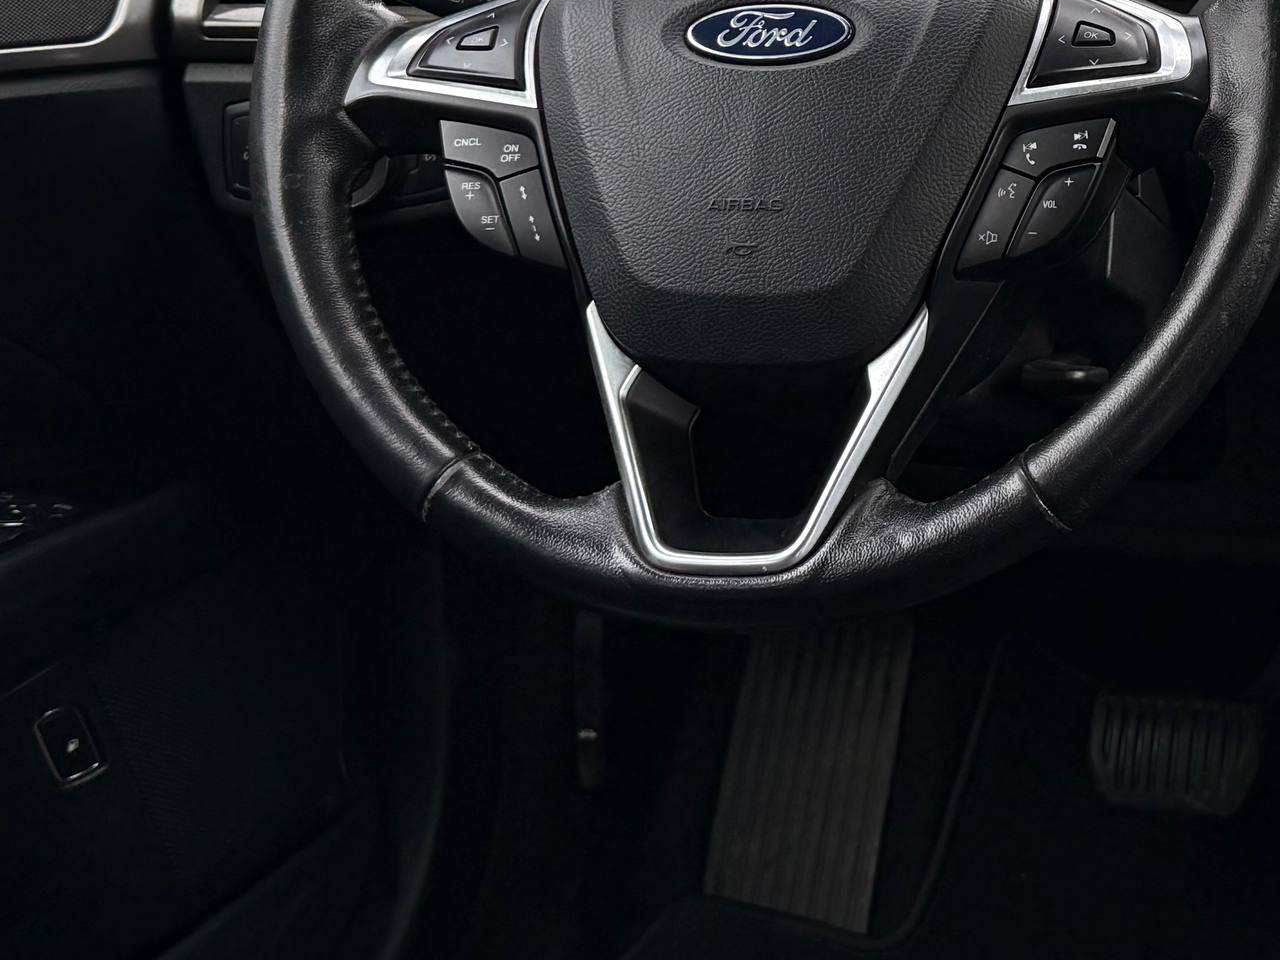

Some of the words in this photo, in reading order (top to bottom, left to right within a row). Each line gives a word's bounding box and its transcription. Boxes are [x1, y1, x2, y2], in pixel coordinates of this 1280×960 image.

[716, 11, 818, 48] Ford
[1083, 31, 1098, 39] OK
[453, 138, 482, 147] CNCL
[503, 144, 519, 153] ON
[500, 153, 521, 162] OFF
[461, 182, 481, 190] RES
[708, 197, 784, 211] AIRBAG
[1043, 200, 1058, 209] VOL
[481, 215, 500, 224] SET
